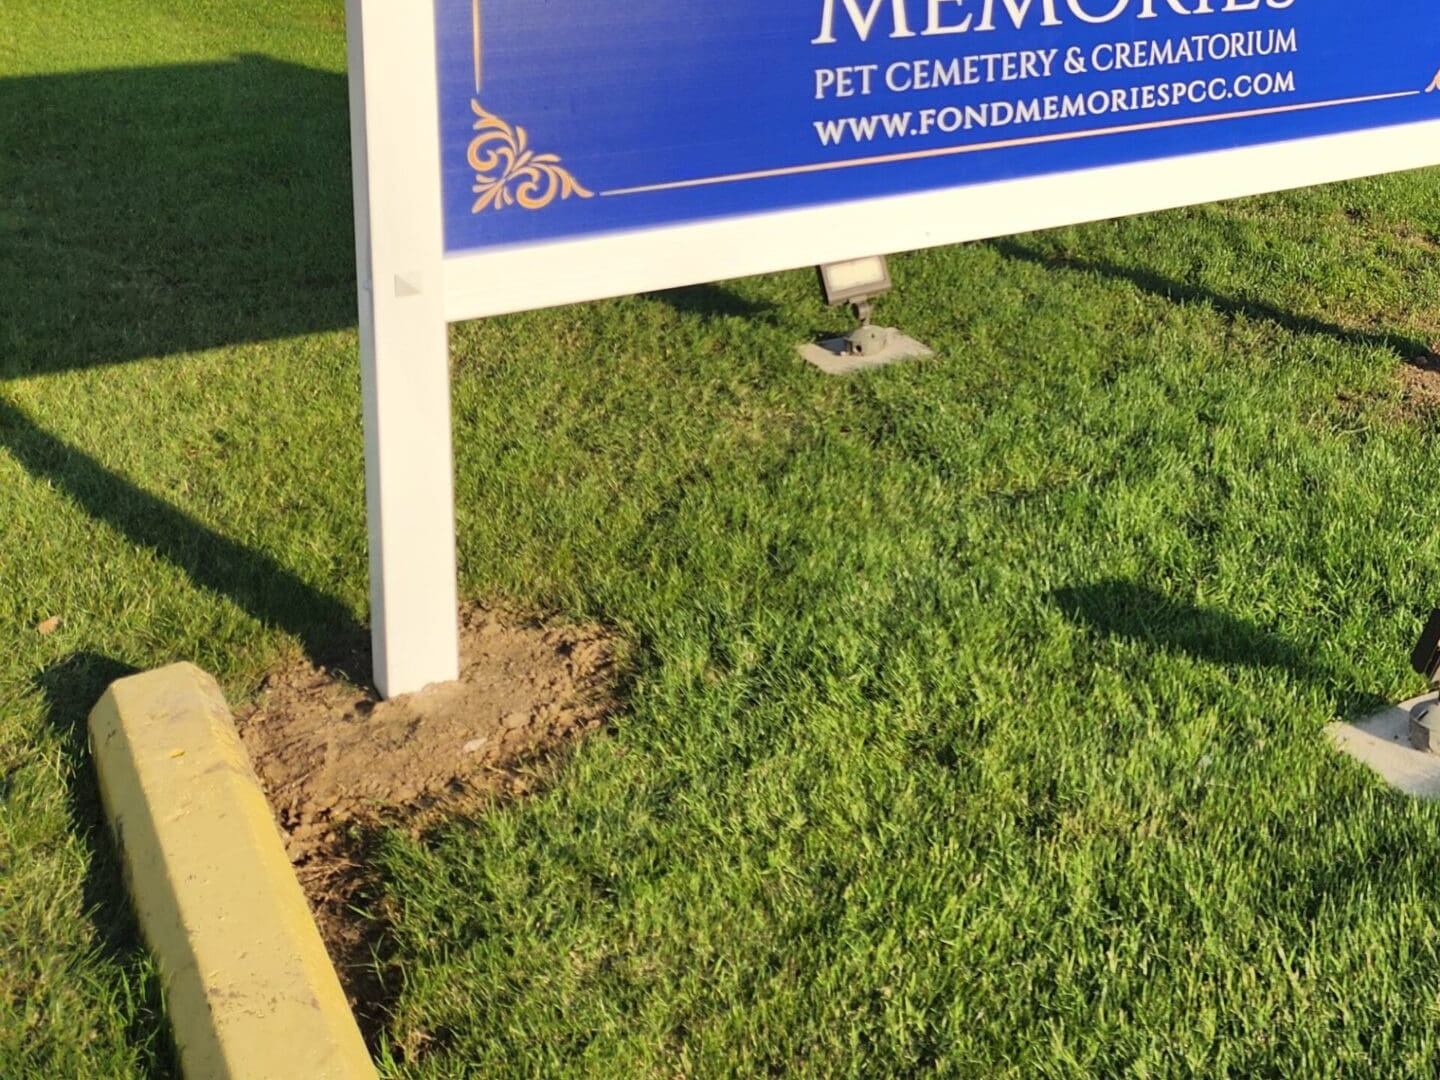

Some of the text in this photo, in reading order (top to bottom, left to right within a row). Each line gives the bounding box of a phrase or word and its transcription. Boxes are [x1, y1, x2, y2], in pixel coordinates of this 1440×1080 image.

[814, 27, 1298, 99] PET CEMETERY & CREMATORIUM
[813, 70, 1296, 147] WWW.FONDMEMORIESPCC.COM
